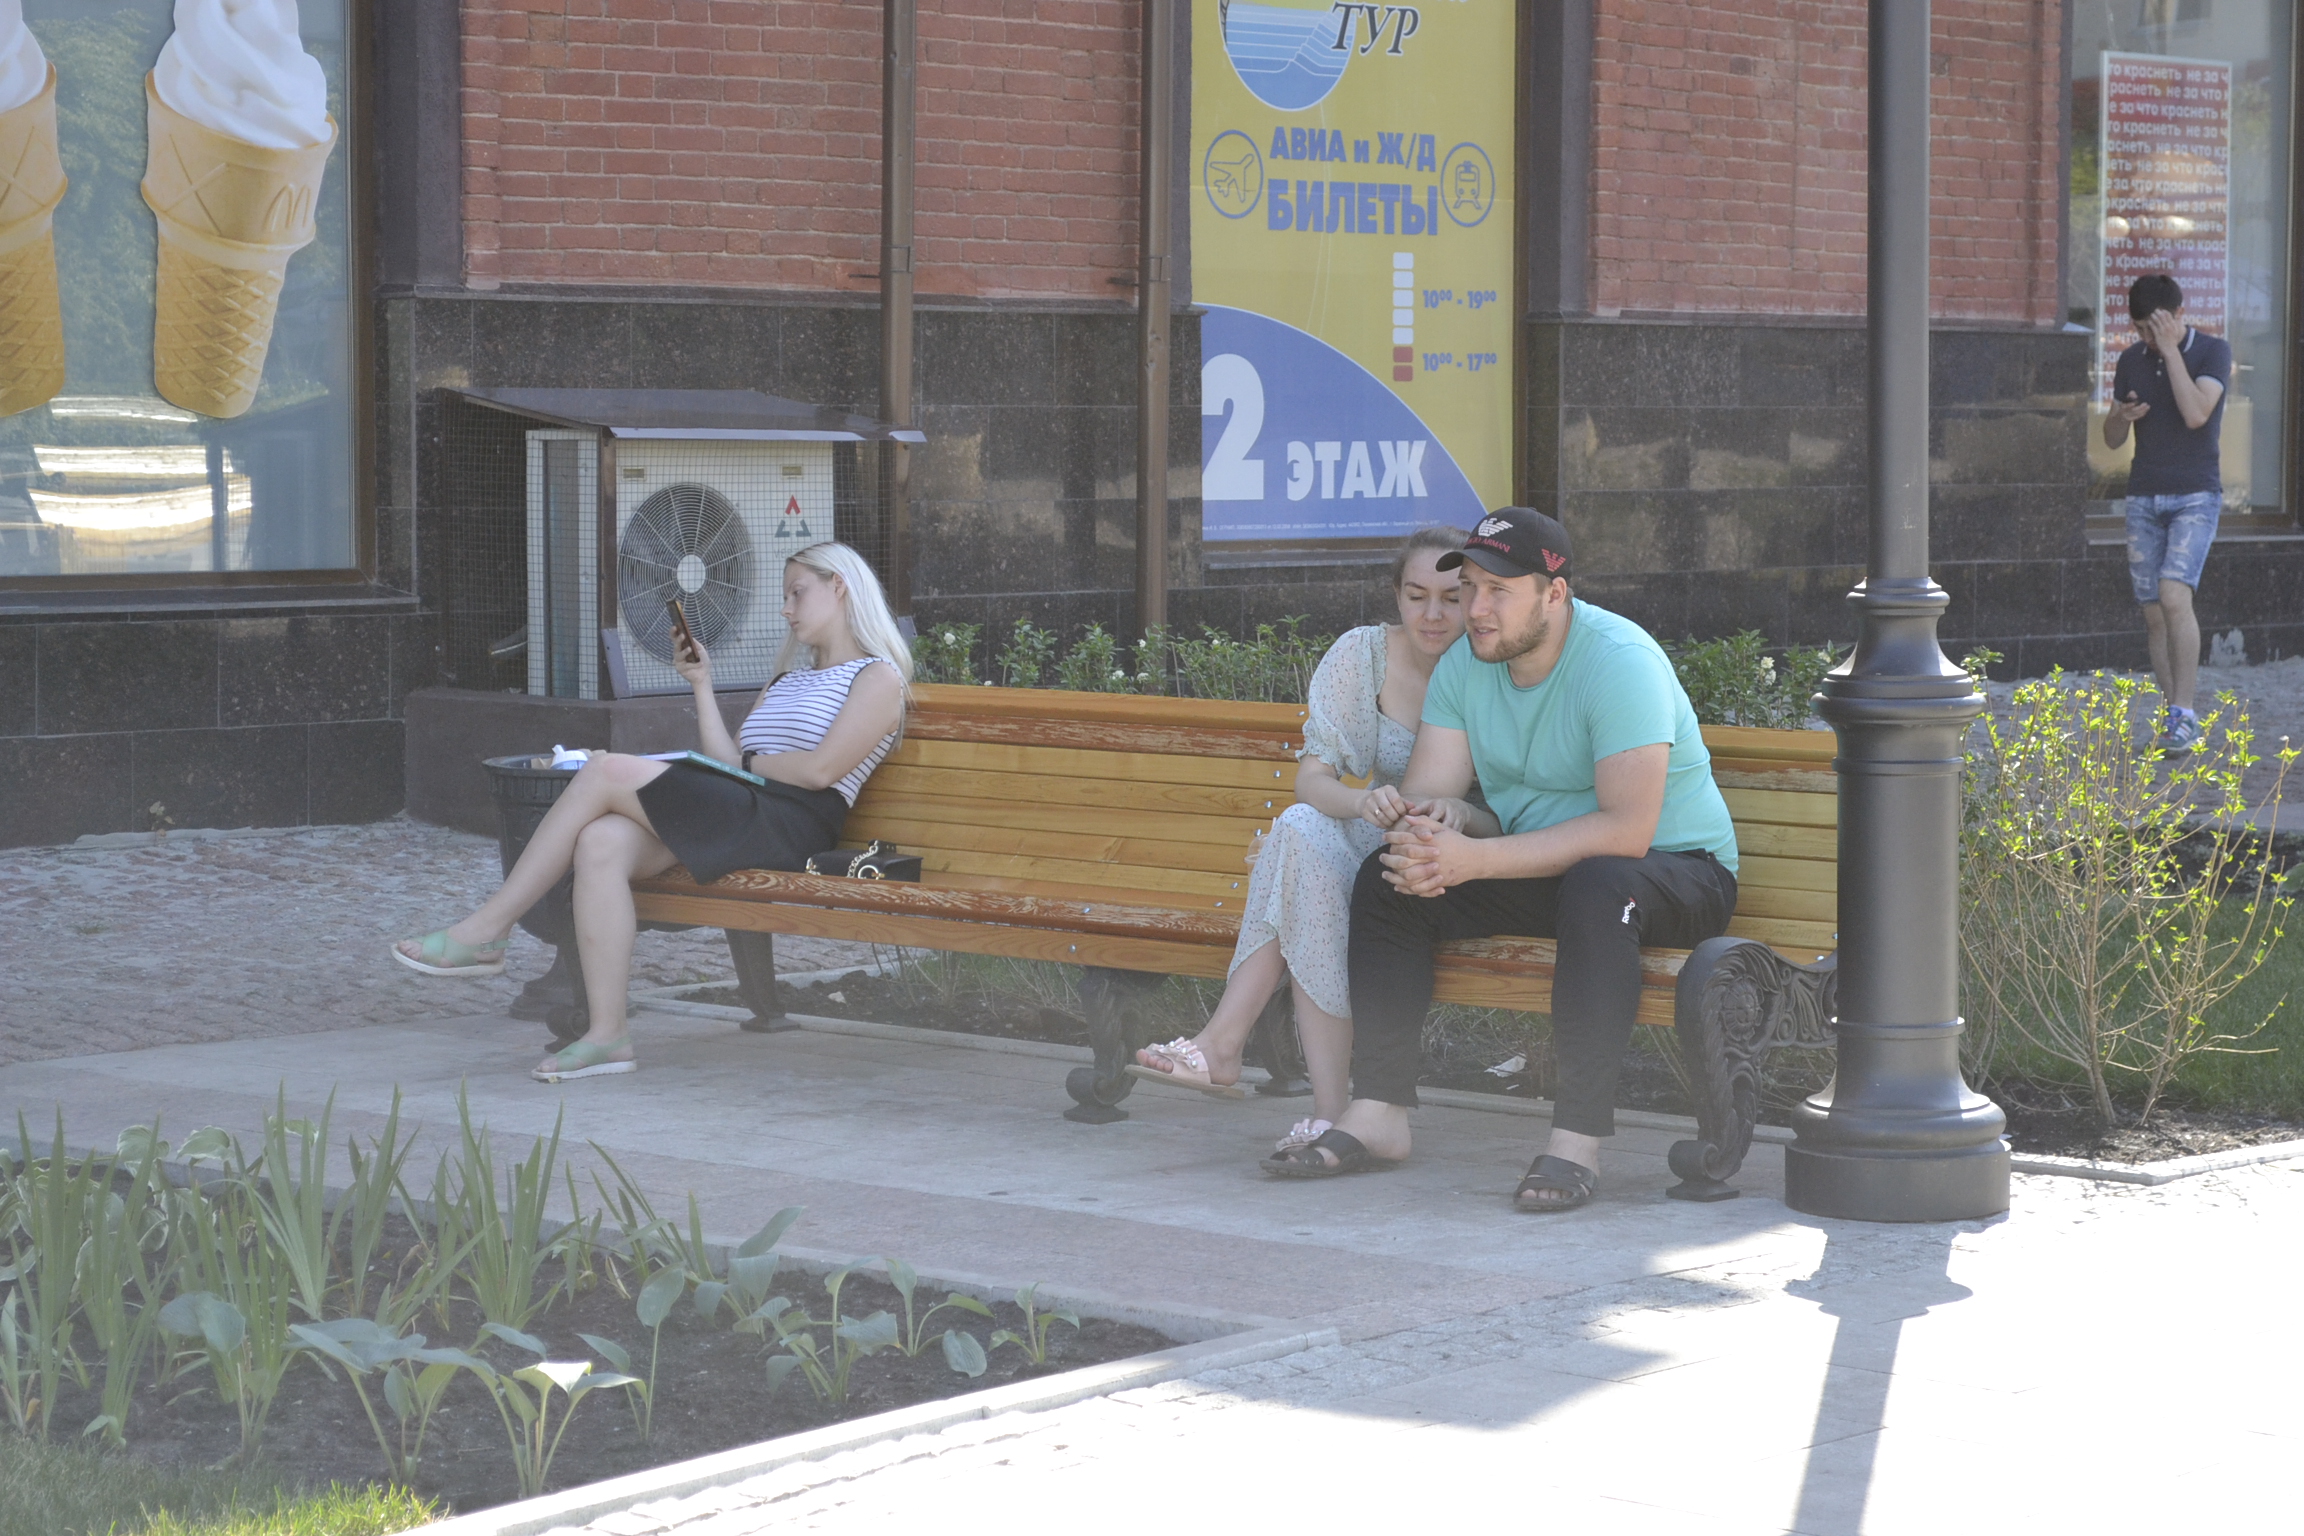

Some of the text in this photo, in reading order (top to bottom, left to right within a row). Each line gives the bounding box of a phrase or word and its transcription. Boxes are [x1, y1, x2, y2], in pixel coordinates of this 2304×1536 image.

[1330, 1, 1420, 55] ТУР
[2124, 64, 2182, 80] краснеть
[2187, 70, 2201, 82] не
[2203, 71, 2218, 83] за
[2166, 85, 2181, 97] не
[2184, 87, 2198, 99] за
[2201, 88, 2221, 100] что
[2119, 102, 2134, 114] за
[2137, 103, 2158, 116] что
[2161, 105, 2218, 121] краснеть
[2123, 121, 2181, 137] краснеть
[2186, 126, 2201, 137] не
[2203, 127, 2218, 138] за
[1270, 126, 1436, 173] АВИА и Ж/Д
[2191, 145, 2212, 157] что
[2155, 161, 2170, 173] за
[2172, 162, 2194, 174] что
[2156, 181, 2212, 196] краснеть
[1268, 178, 1438, 236] БИЛЕТЫ
[1202, 353, 1429, 501] 2 ЭТАЖ
